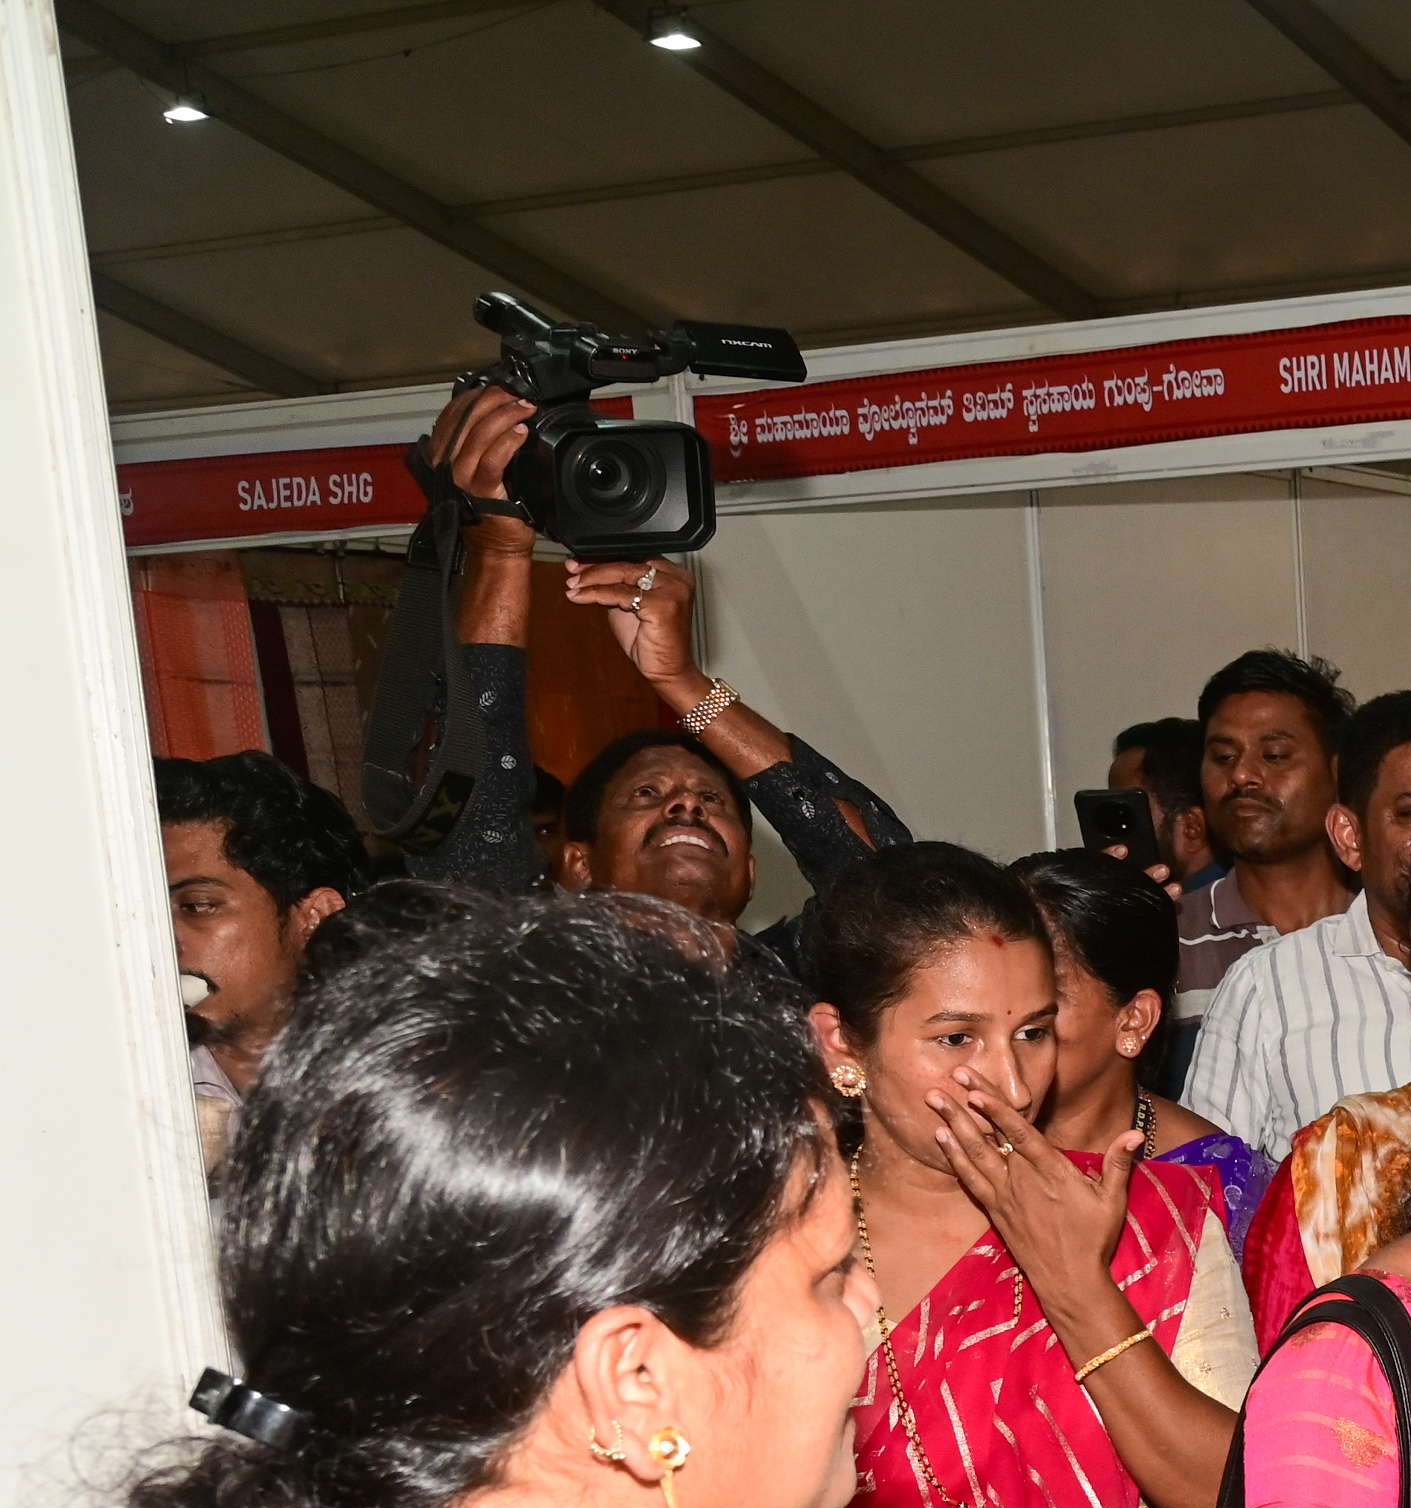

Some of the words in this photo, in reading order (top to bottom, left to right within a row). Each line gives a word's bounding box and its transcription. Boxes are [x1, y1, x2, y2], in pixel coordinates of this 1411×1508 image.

[612, 347, 638, 356] SONY
[1279, 353, 1328, 394] SHRI
[729, 413, 749, 458] ಶ್ರೀ
[755, 402, 850, 444] ಮಹಾಮಾಯಾ
[1022, 374, 1096, 433] ಸ್ವಸಹಾಯ
[237, 475, 322, 512] SAJEDA
[328, 472, 374, 505] SHG
